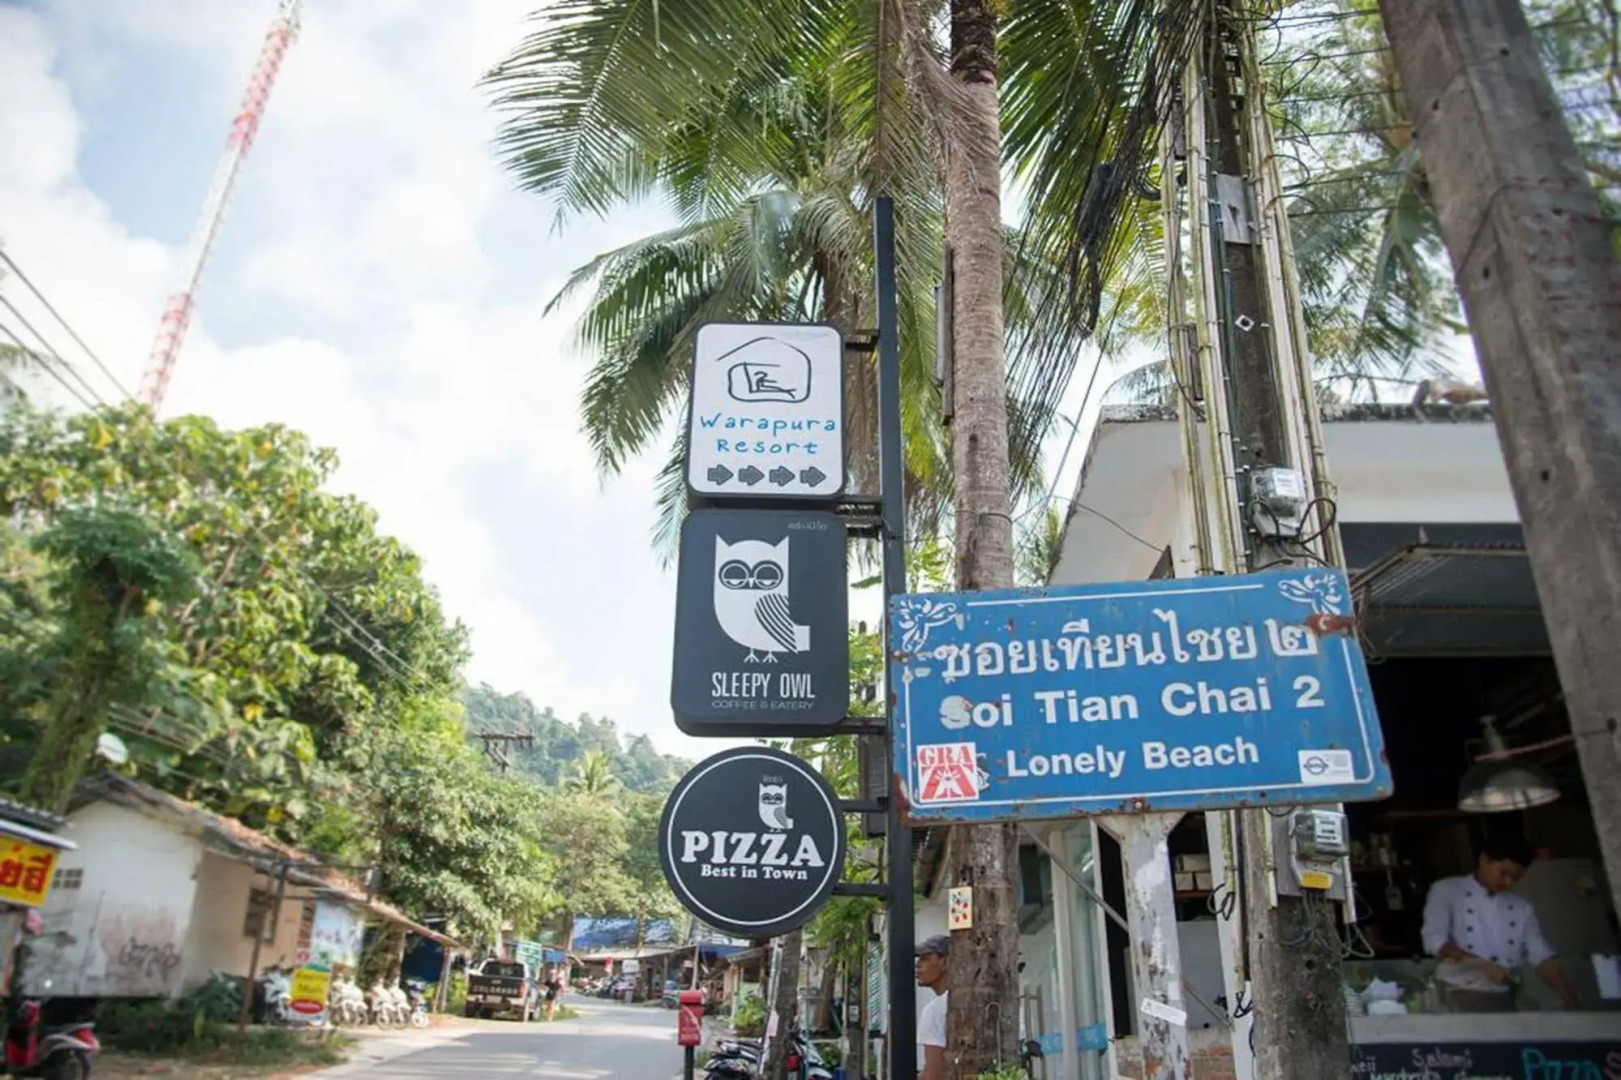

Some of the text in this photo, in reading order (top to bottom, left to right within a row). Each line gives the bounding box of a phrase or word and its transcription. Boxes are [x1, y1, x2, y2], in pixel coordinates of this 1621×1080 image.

[700, 413, 836, 437] Warapura
[717, 439, 818, 454] Resort
[712, 672, 815, 698] SLEEPY OWL
[712, 700, 757, 710] COFFEE
[771, 700, 815, 710] EATERY
[1034, 689, 1139, 724] Tian
[1161, 677, 1272, 717] Chai
[1293, 675, 1325, 708] 2
[1007, 736, 1260, 779] Lonely Beach
[681, 830, 825, 867] PIZZA
[701, 864, 808, 880] Best in Town
